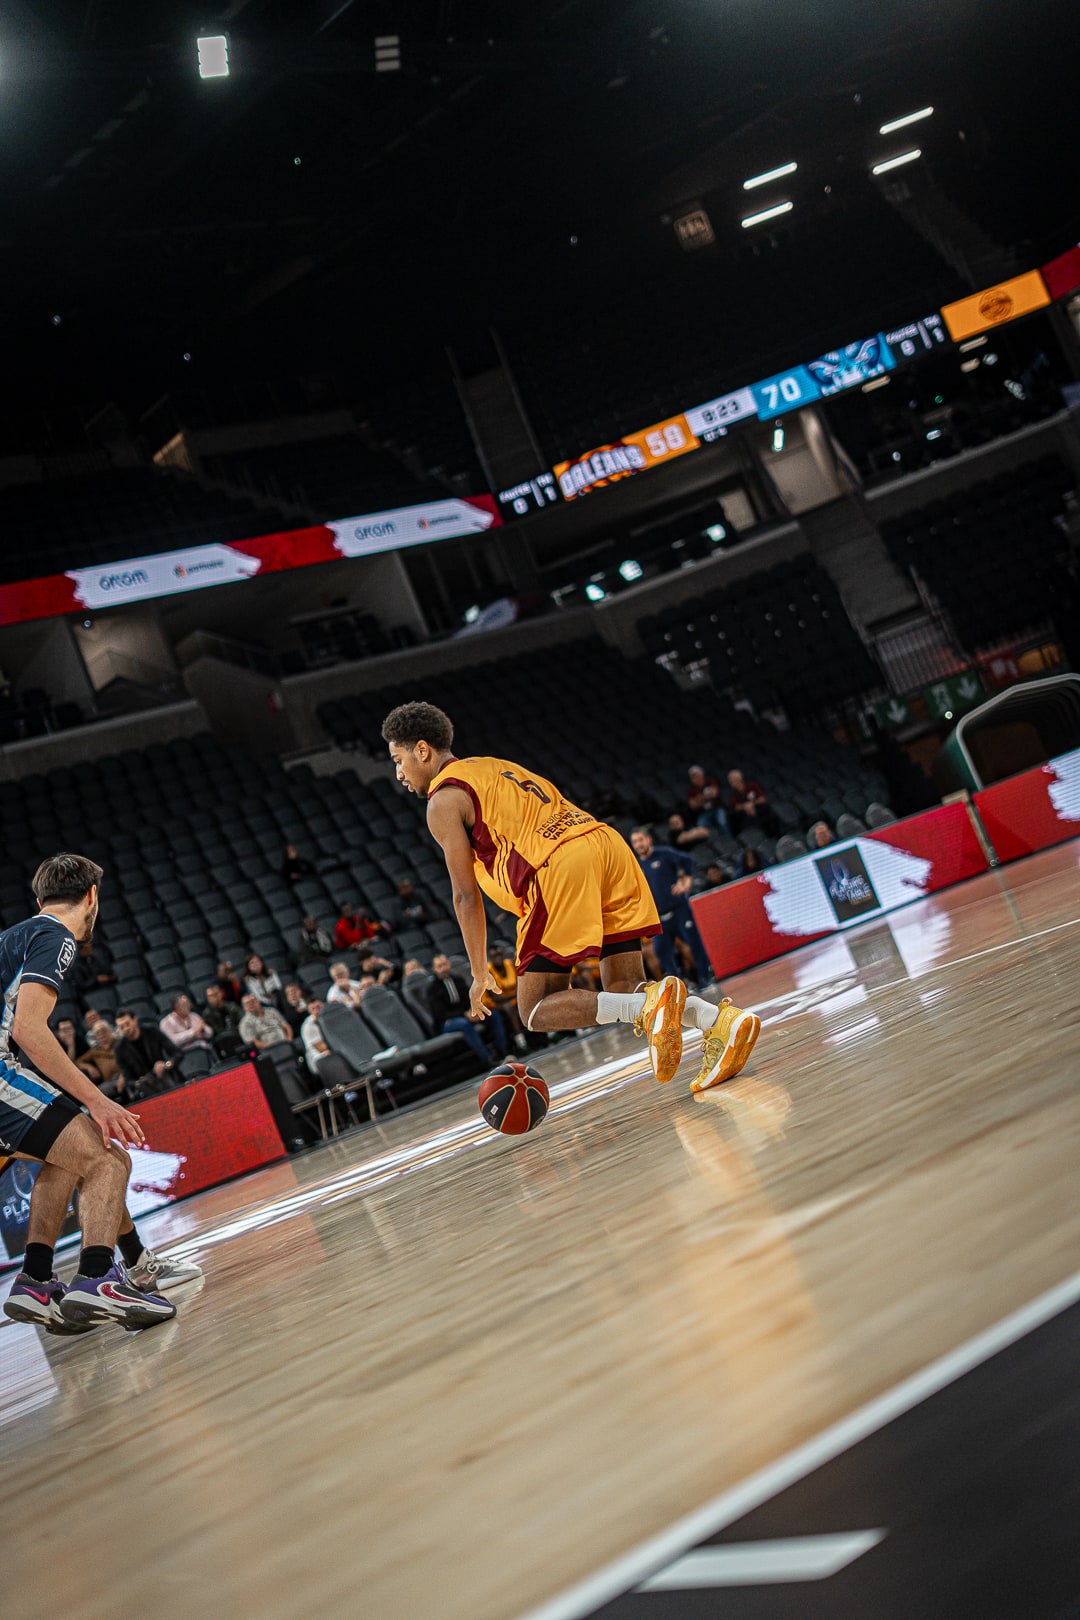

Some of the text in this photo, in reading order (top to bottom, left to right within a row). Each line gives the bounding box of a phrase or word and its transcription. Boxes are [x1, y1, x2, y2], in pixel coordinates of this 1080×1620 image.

[761, 377, 801, 410] 70
[550, 827, 568, 840] VAL
[564, 818, 578, 827] DE
[2, 1199, 31, 1220] PLA
